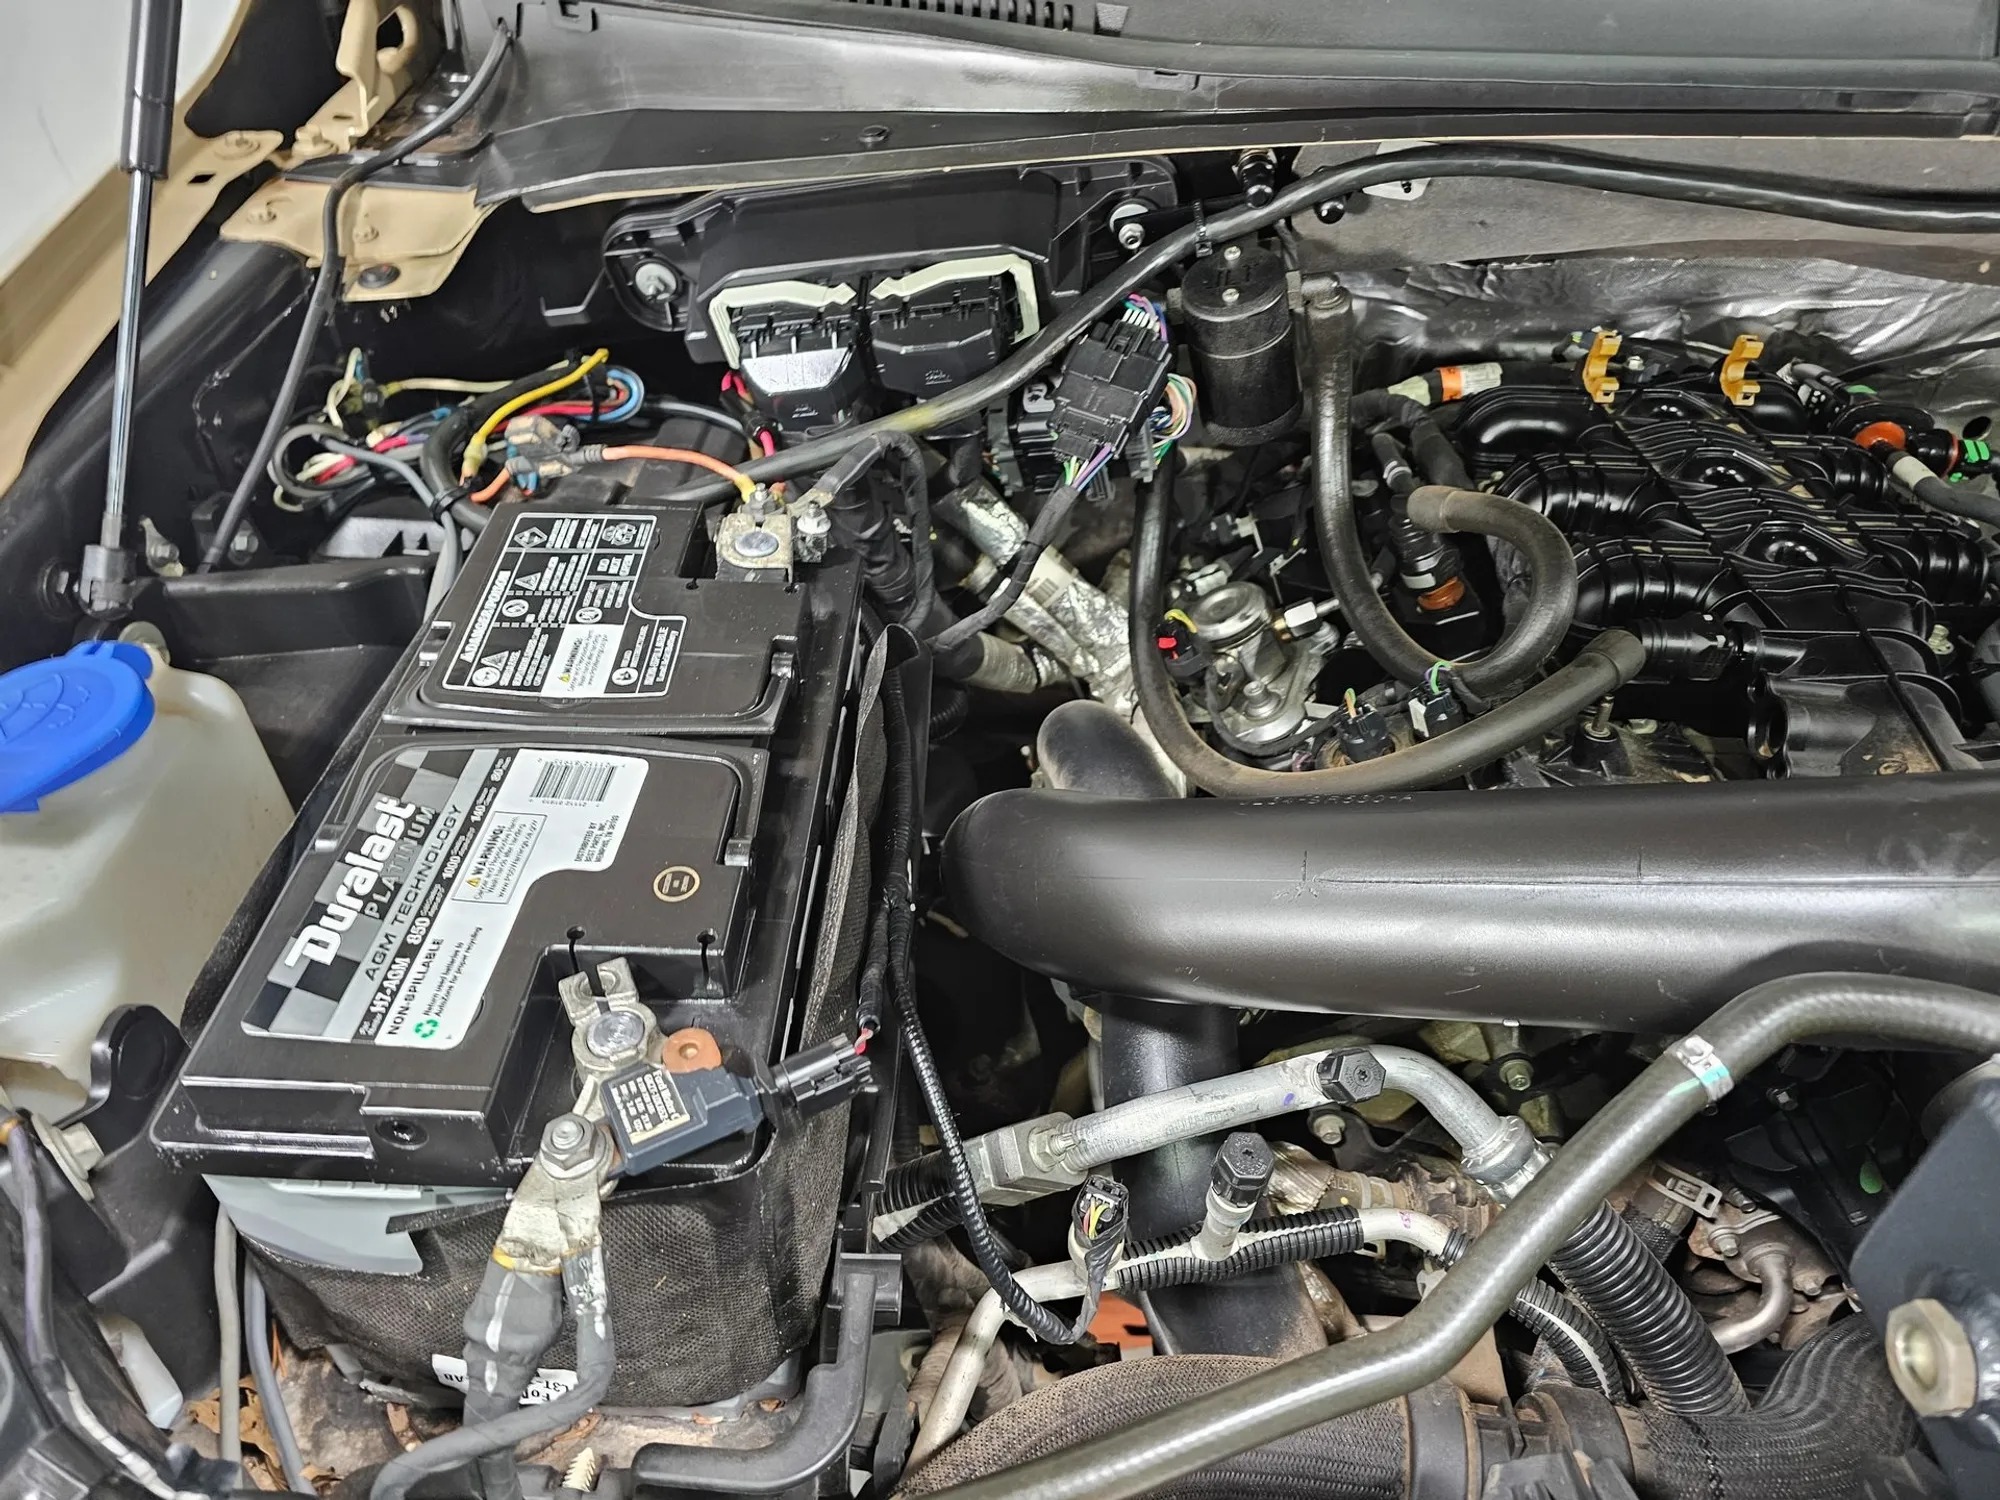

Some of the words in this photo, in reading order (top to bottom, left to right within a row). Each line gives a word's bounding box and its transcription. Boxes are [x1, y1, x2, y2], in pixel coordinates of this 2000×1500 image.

[284, 797, 416, 968] Duralast
[364, 806, 437, 919] PLATINUM
[364, 931, 397, 982] AGM
[391, 804, 463, 926] TECHNOLOGY
[471, 824, 506, 875] WARNING:
[368, 956, 412, 1014] H7-AGM
[406, 916, 431, 945] 850
[441, 855, 462, 879] 1000
[470, 803, 486, 822] 140
[386, 938, 444, 1034] NON-SPILLABLE
[432, 984, 454, 1016] AutoZone
[447, 974, 459, 983] for
[453, 954, 470, 973] proper
